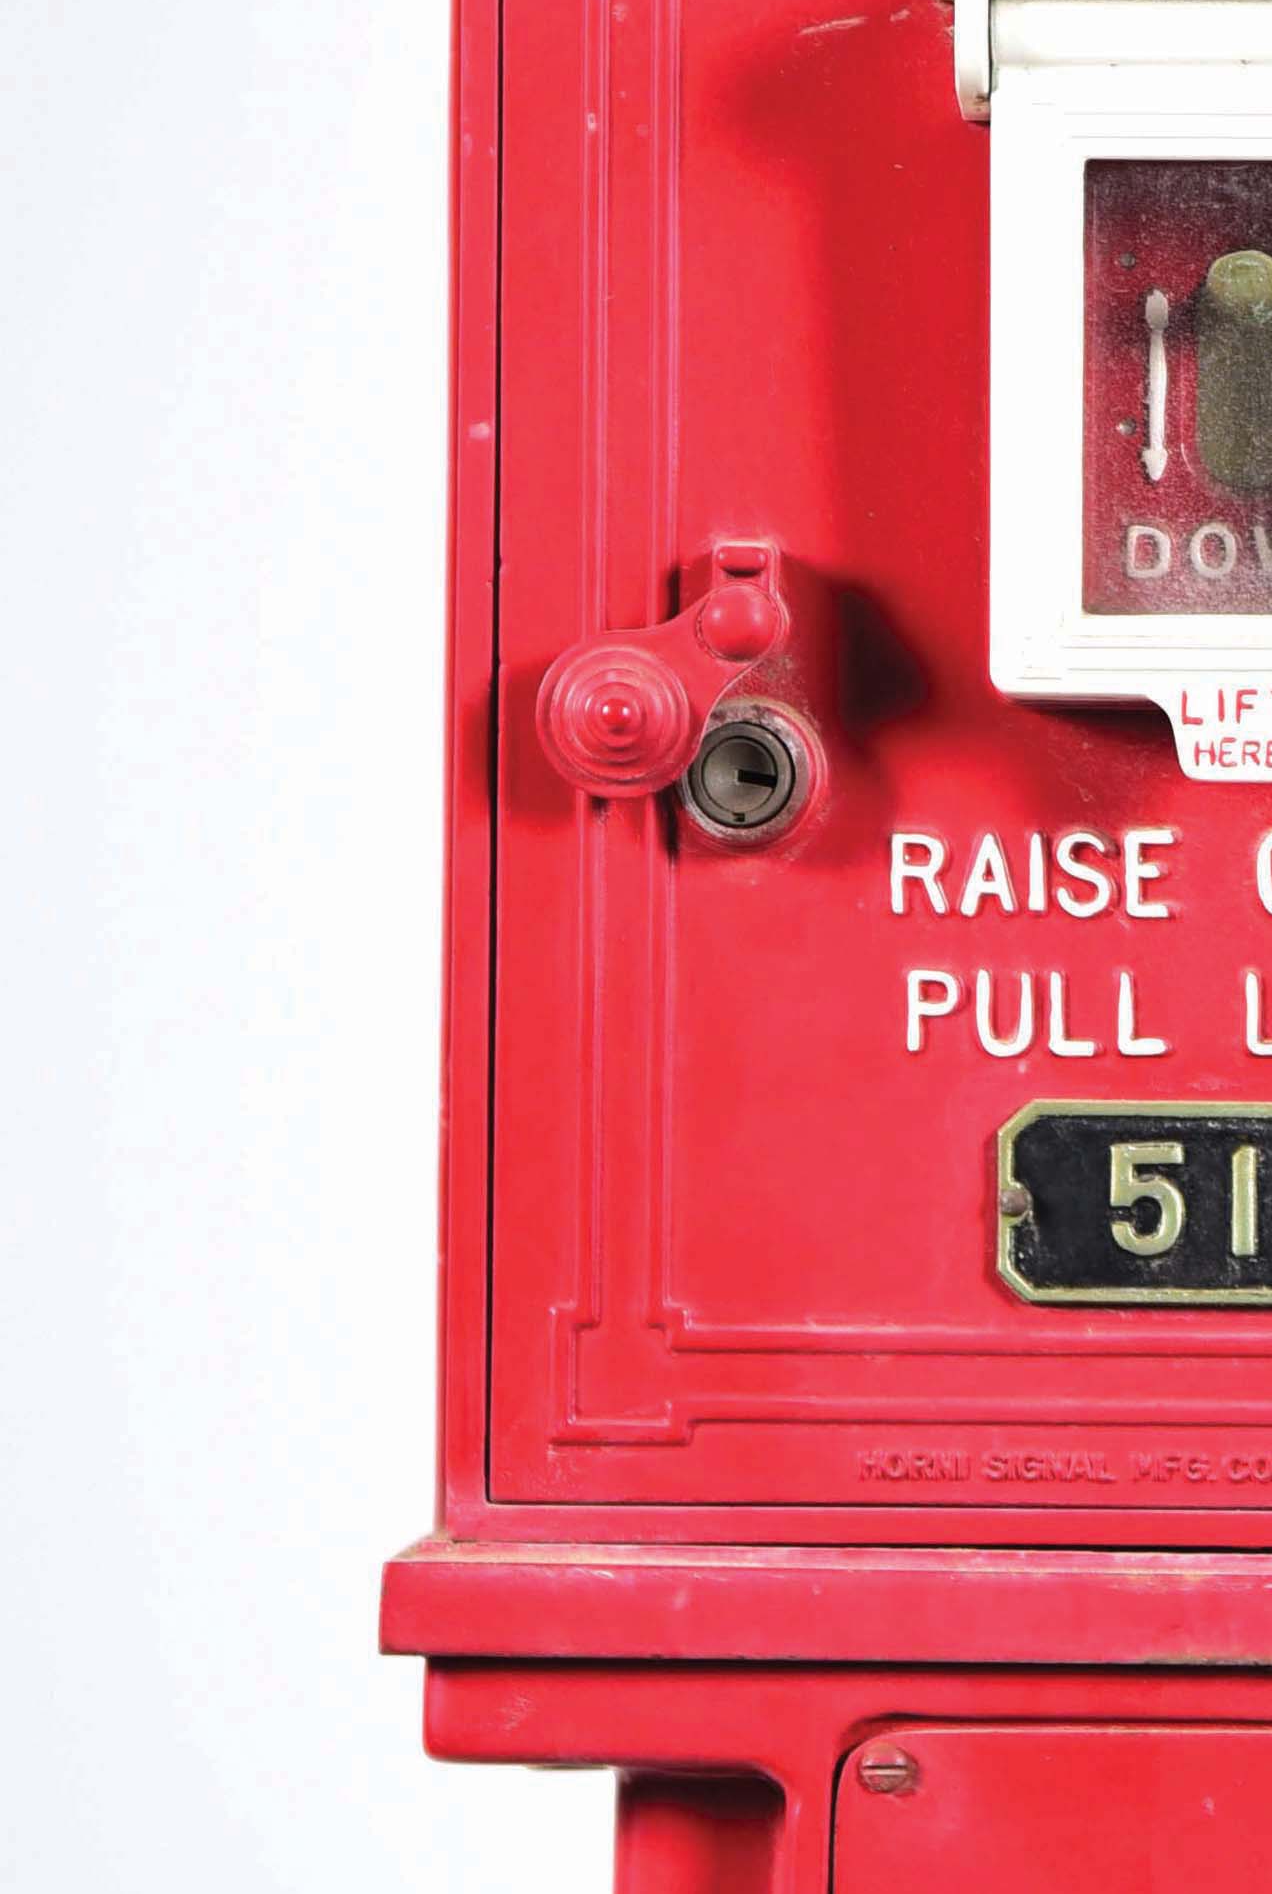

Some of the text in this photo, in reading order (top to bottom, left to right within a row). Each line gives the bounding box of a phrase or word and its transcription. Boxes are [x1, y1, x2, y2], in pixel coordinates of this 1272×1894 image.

[890, 828, 1176, 918] RAISE
[906, 969, 1168, 1057] PULL
[857, 1451, 970, 1482] HORNI
[982, 1451, 1118, 1484] SIGNAL
